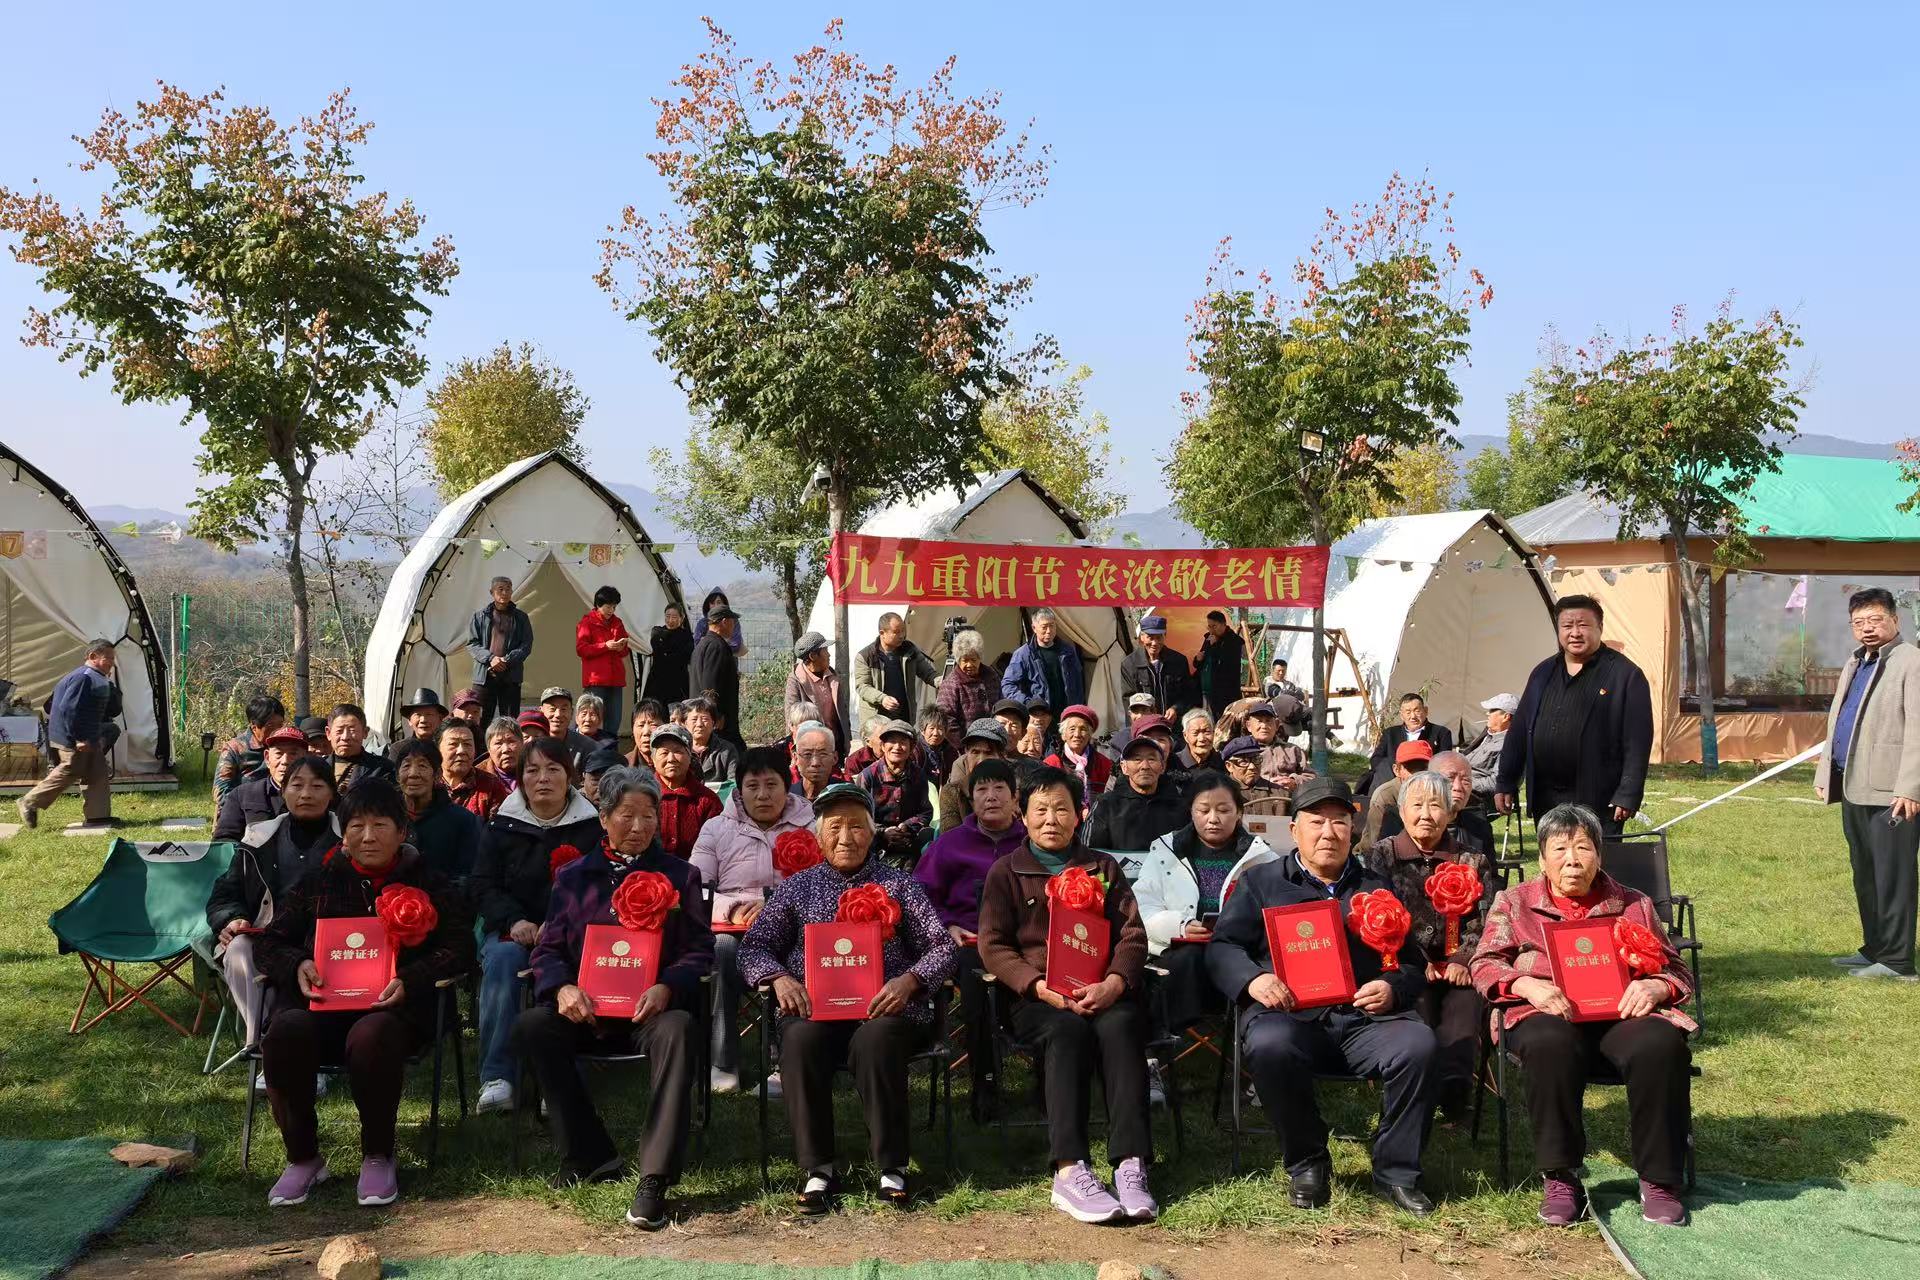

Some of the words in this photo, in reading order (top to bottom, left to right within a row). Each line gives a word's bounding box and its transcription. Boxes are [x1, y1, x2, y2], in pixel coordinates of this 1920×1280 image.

[6, 537, 17, 553] 7
[836, 545, 1065, 600] 九九重阳节
[1076, 556, 1303, 601] 浓浓敬老情
[1062, 933, 1098, 957] 荣誉证书
[1285, 937, 1332, 953] 荣誉证书
[330, 948, 379, 960] 荣誉证书
[820, 954, 868, 968] 荣誉证书
[1564, 953, 1611, 968] 荣誉证书
[595, 956, 642, 968] 荣誉证书
